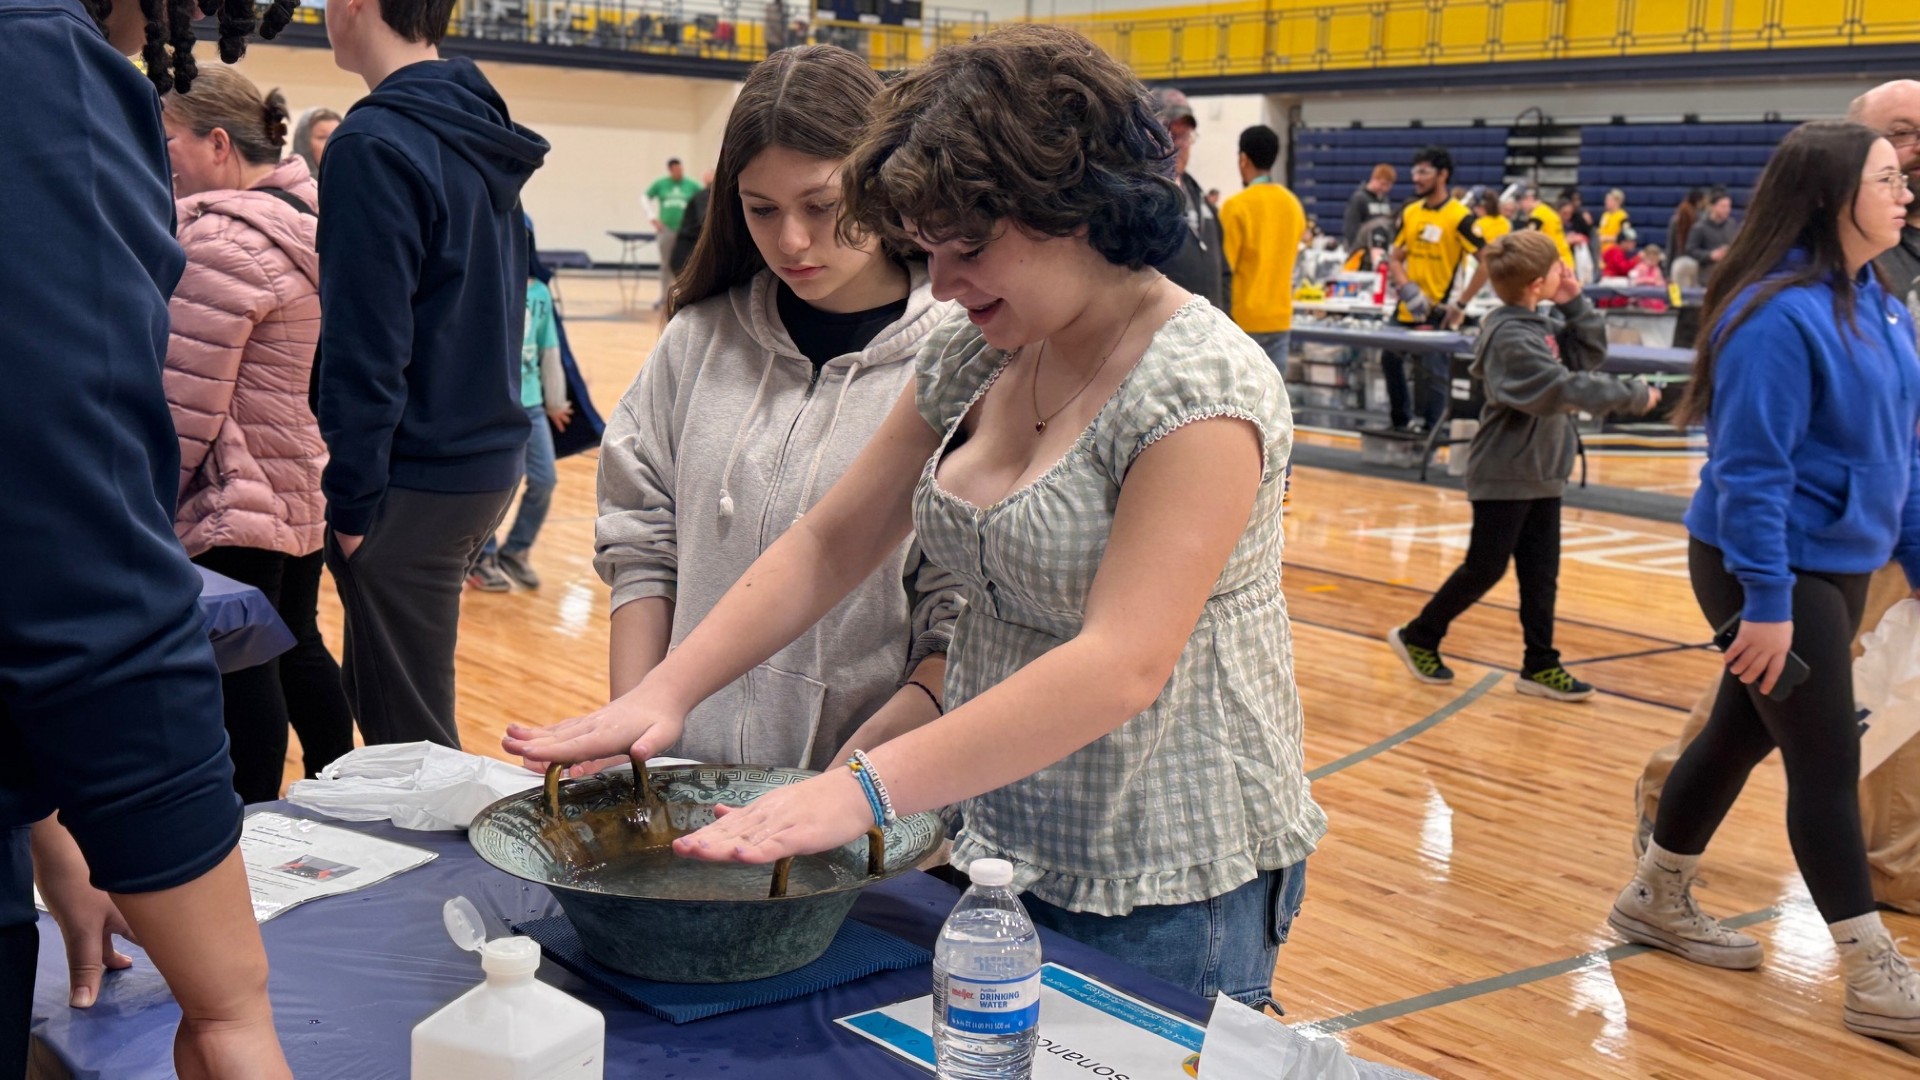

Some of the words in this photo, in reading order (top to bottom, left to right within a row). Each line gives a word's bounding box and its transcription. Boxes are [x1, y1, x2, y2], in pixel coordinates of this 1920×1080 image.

[952, 988, 974, 1000] meijer
[980, 991, 1020, 1001] DRINKING
[1036, 1034, 1130, 1080] sonanc
